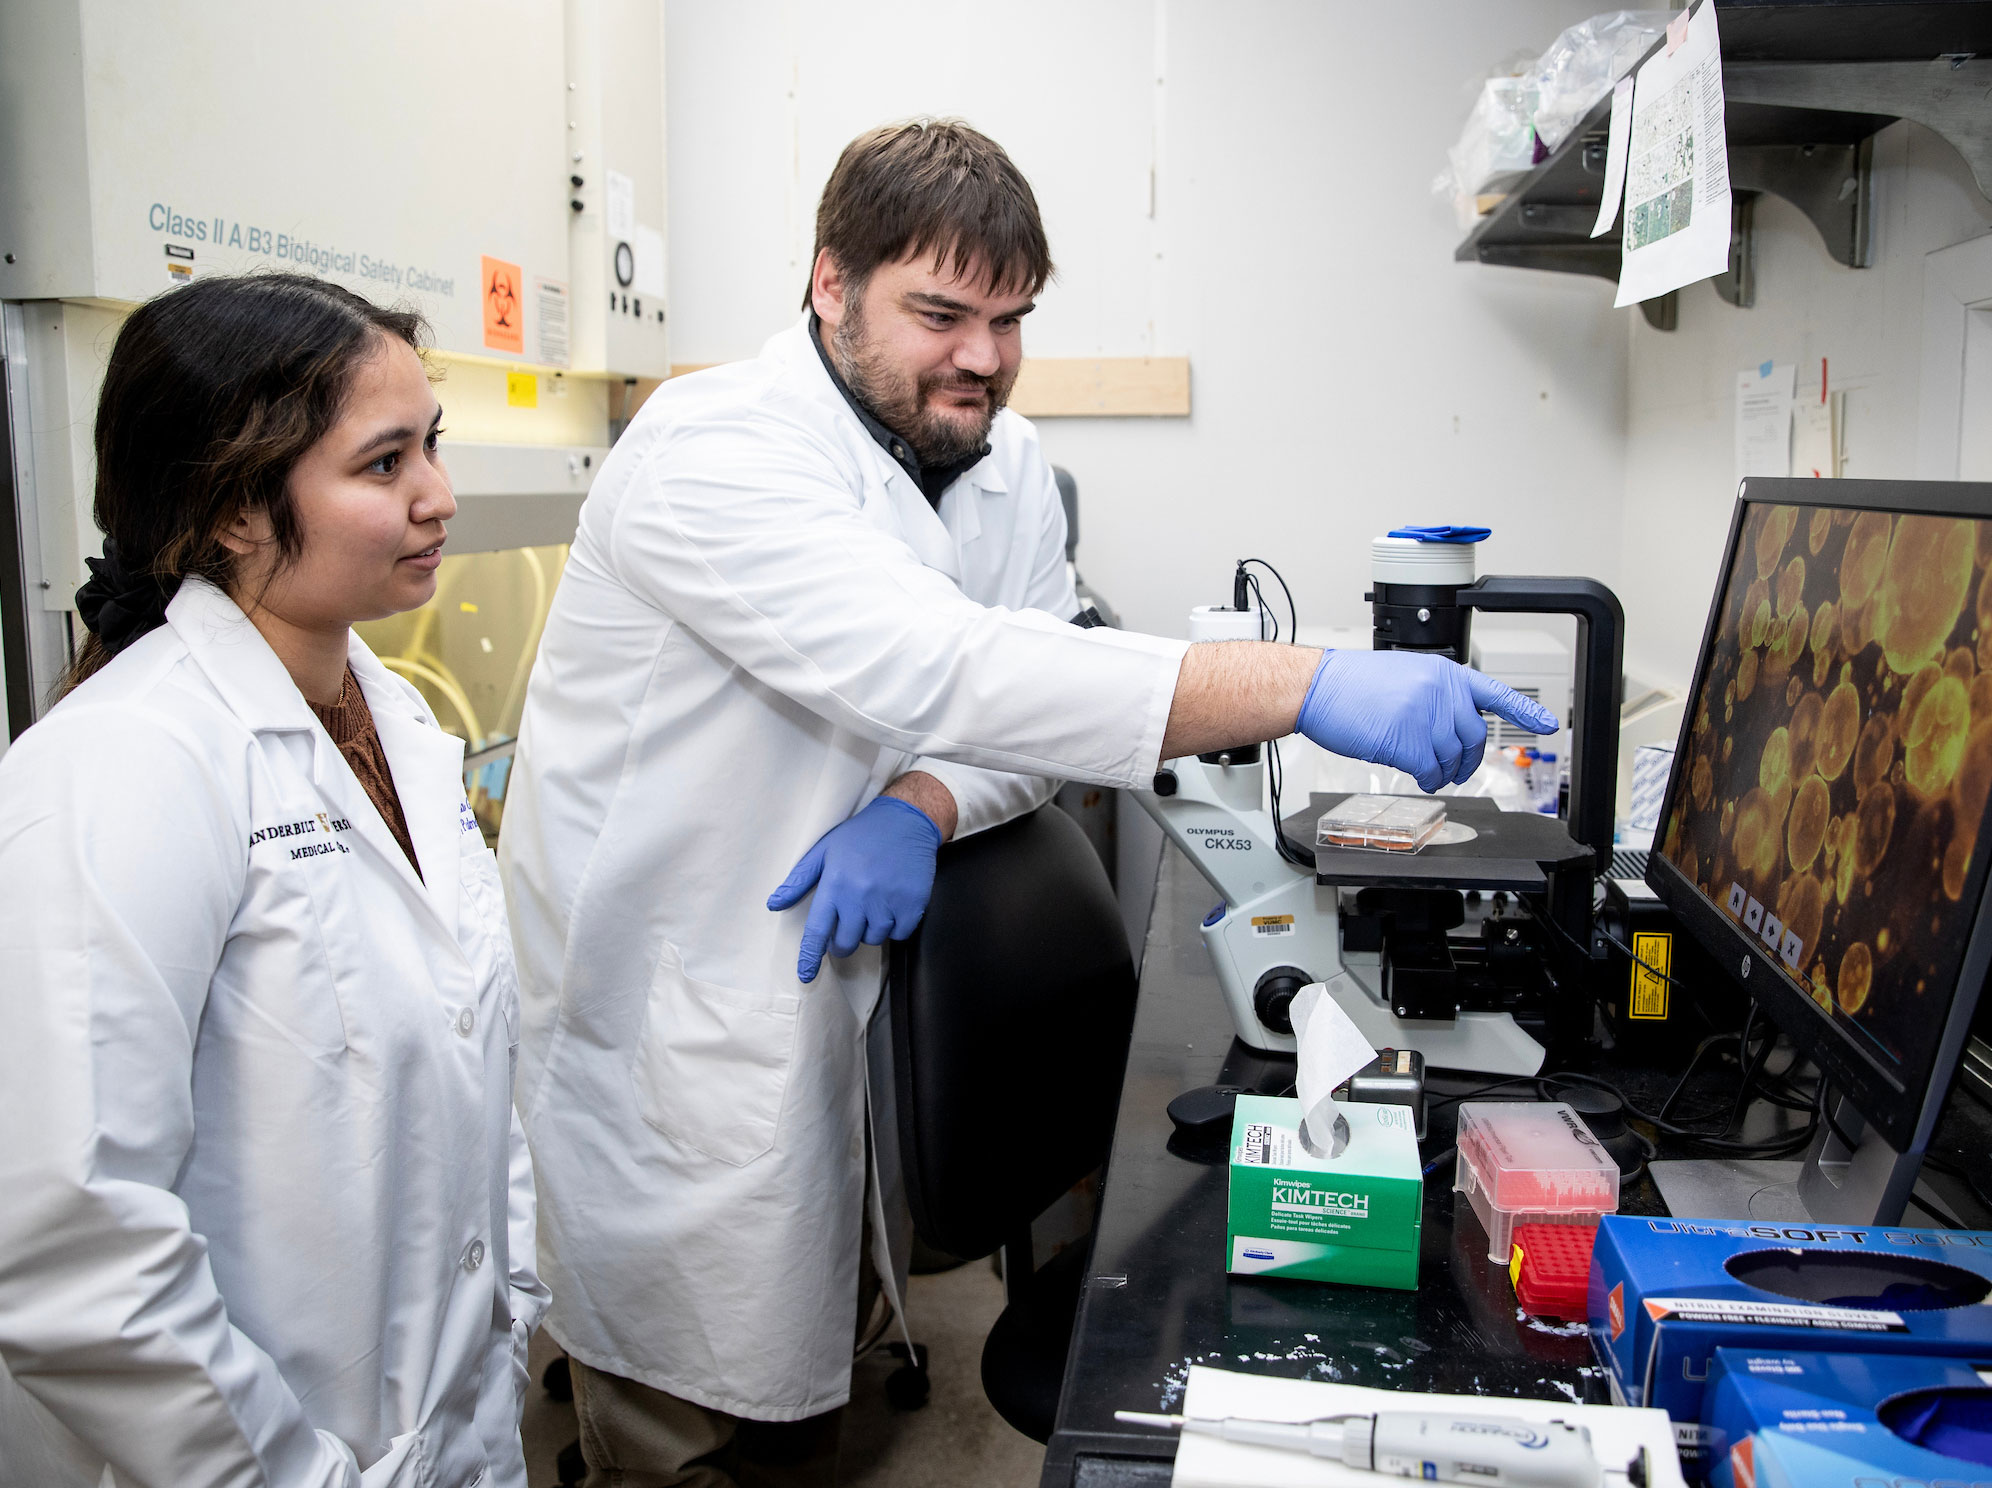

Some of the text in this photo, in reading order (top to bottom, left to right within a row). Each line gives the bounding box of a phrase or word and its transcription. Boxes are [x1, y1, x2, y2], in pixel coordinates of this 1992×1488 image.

[149, 202, 455, 298] Class II A/B3 Biological Safety Cabinet
[1186, 828, 1235, 836] OLYMPUS
[290, 842, 336, 860] MEDICAL
[1205, 838, 1252, 851] CKX53
[1557, 1109, 1578, 1129] VWR
[1244, 1124, 1263, 1164] KIMTECH
[1272, 1187, 1369, 1209] KIMTECH
[1674, 1302, 1879, 1320] NITRILE EXAMINATION GLOVES
[1678, 1312, 1721, 1321] POWDER
[1721, 1314, 1746, 1322] FREE
[1753, 1315, 1810, 1327] FLEXIBILITY
[1840, 1321, 1888, 1331] COMFORT
